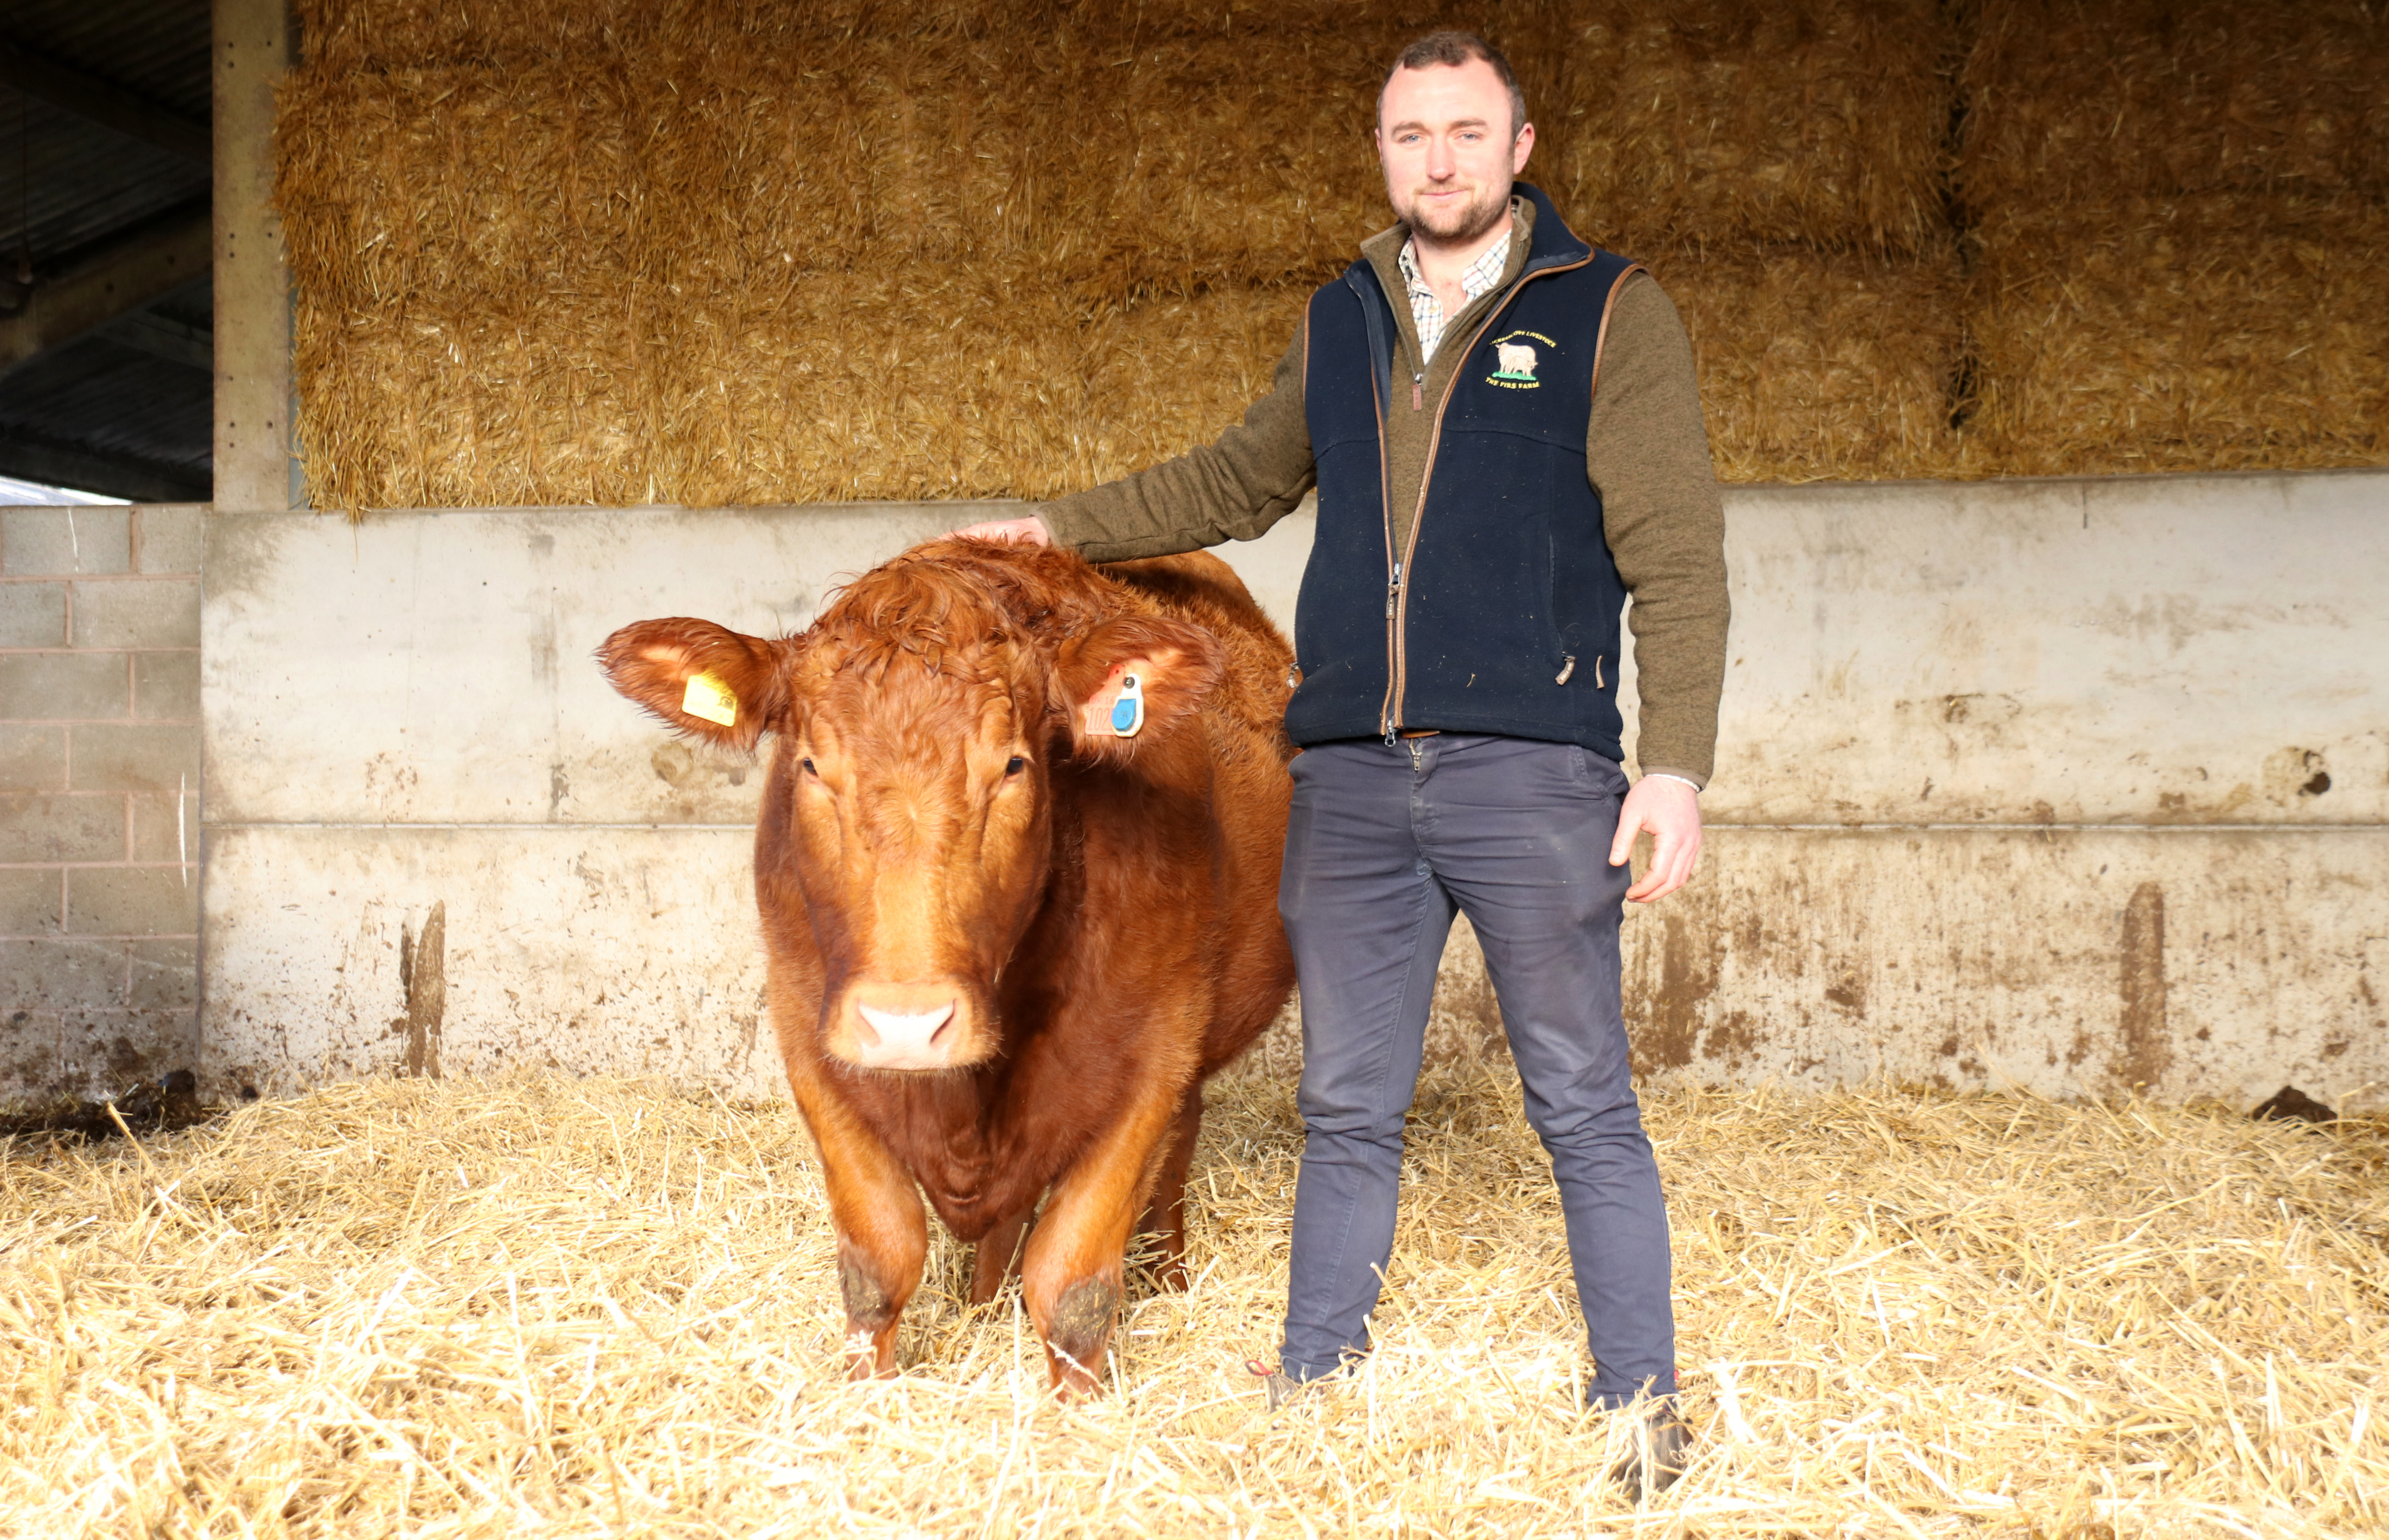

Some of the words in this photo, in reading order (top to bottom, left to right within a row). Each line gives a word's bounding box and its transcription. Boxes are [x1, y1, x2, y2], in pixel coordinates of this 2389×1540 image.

[1526, 331, 1556, 348] LIVESTOCK
[1485, 377, 1499, 386] THE
[1518, 381, 1540, 389] FARM
[1087, 707, 1113, 731] 102
